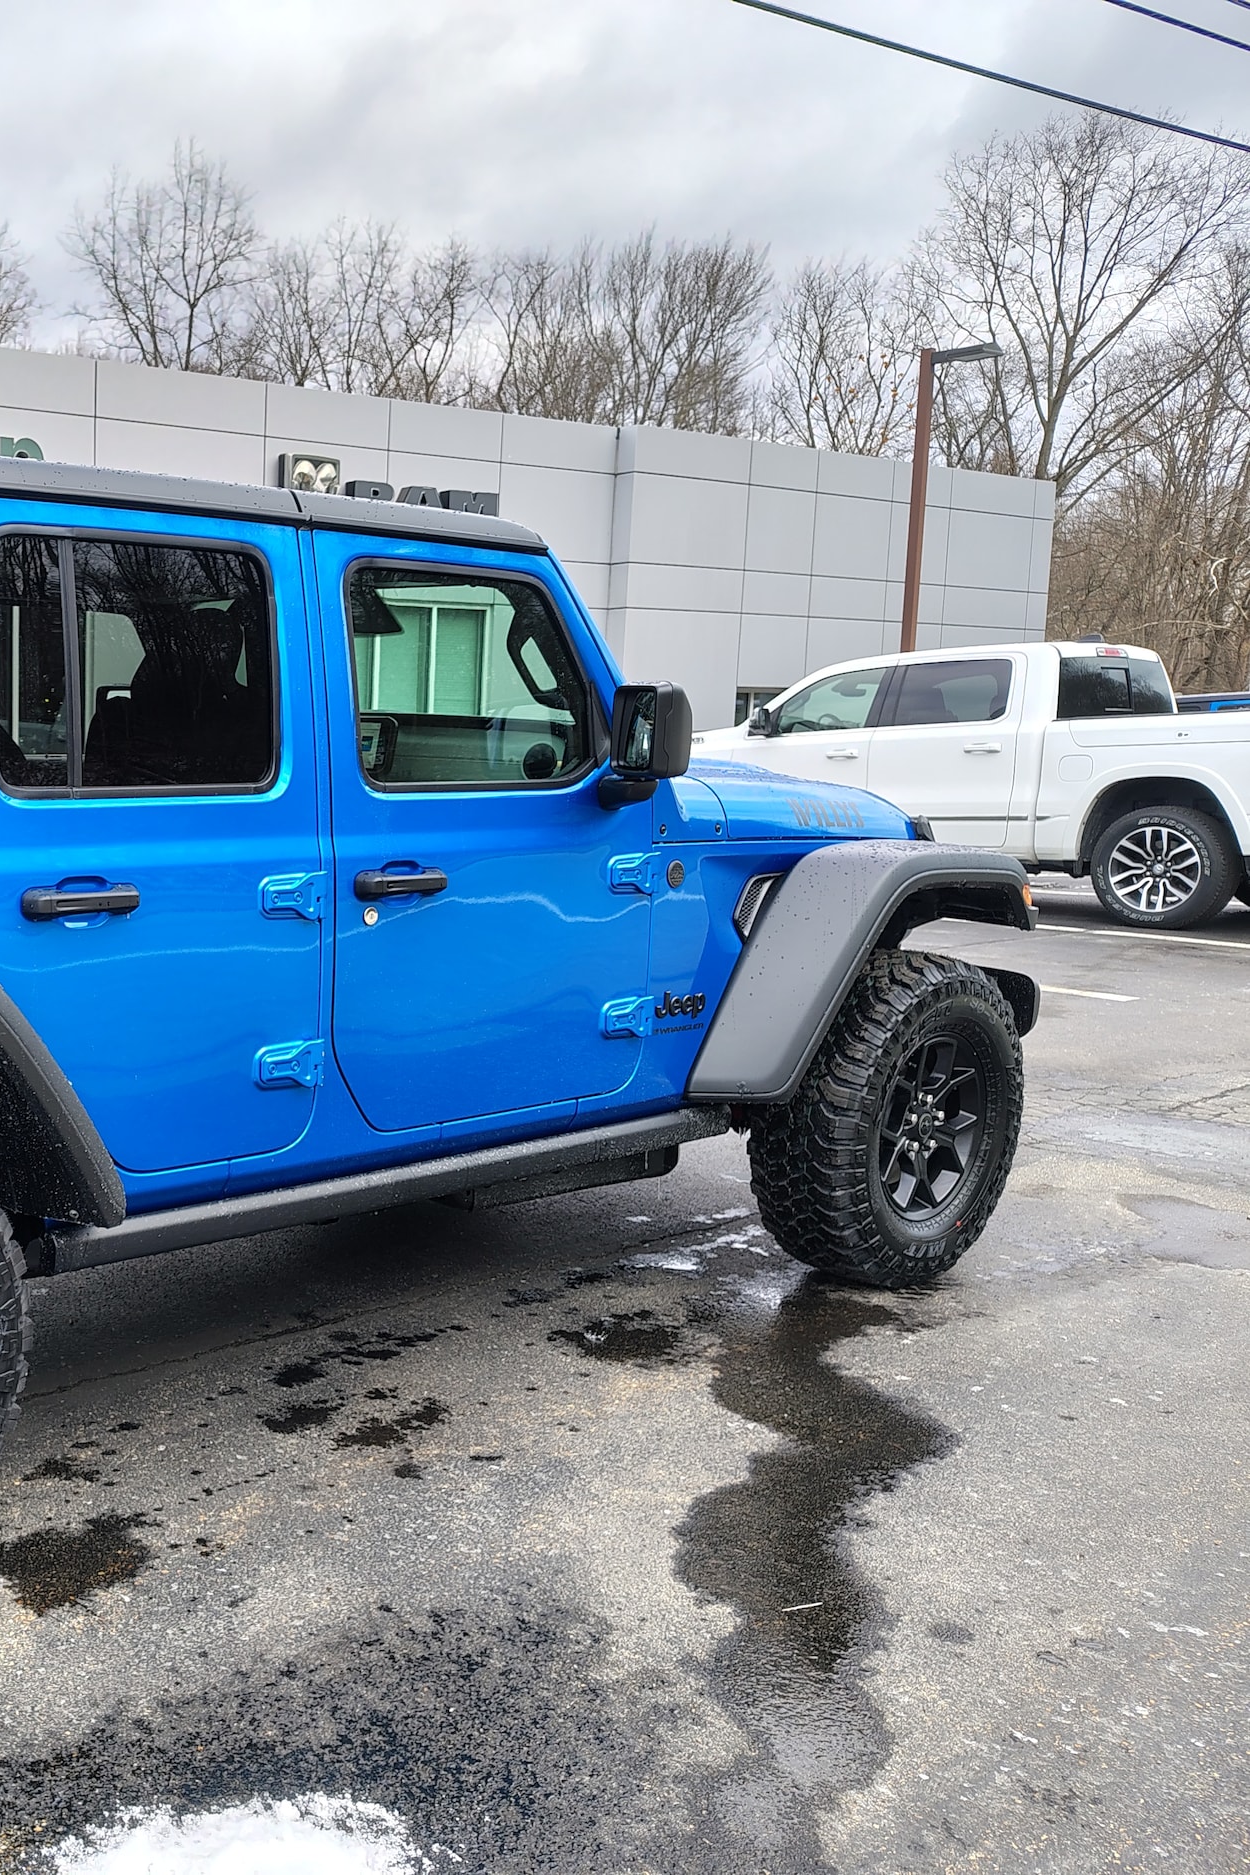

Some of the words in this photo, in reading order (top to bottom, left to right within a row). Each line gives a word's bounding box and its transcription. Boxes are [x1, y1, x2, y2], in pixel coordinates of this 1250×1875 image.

[785, 798, 865, 828] WILLYS
[655, 990, 706, 1019] Jeep
[659, 1022, 705, 1035] WRANGLER
